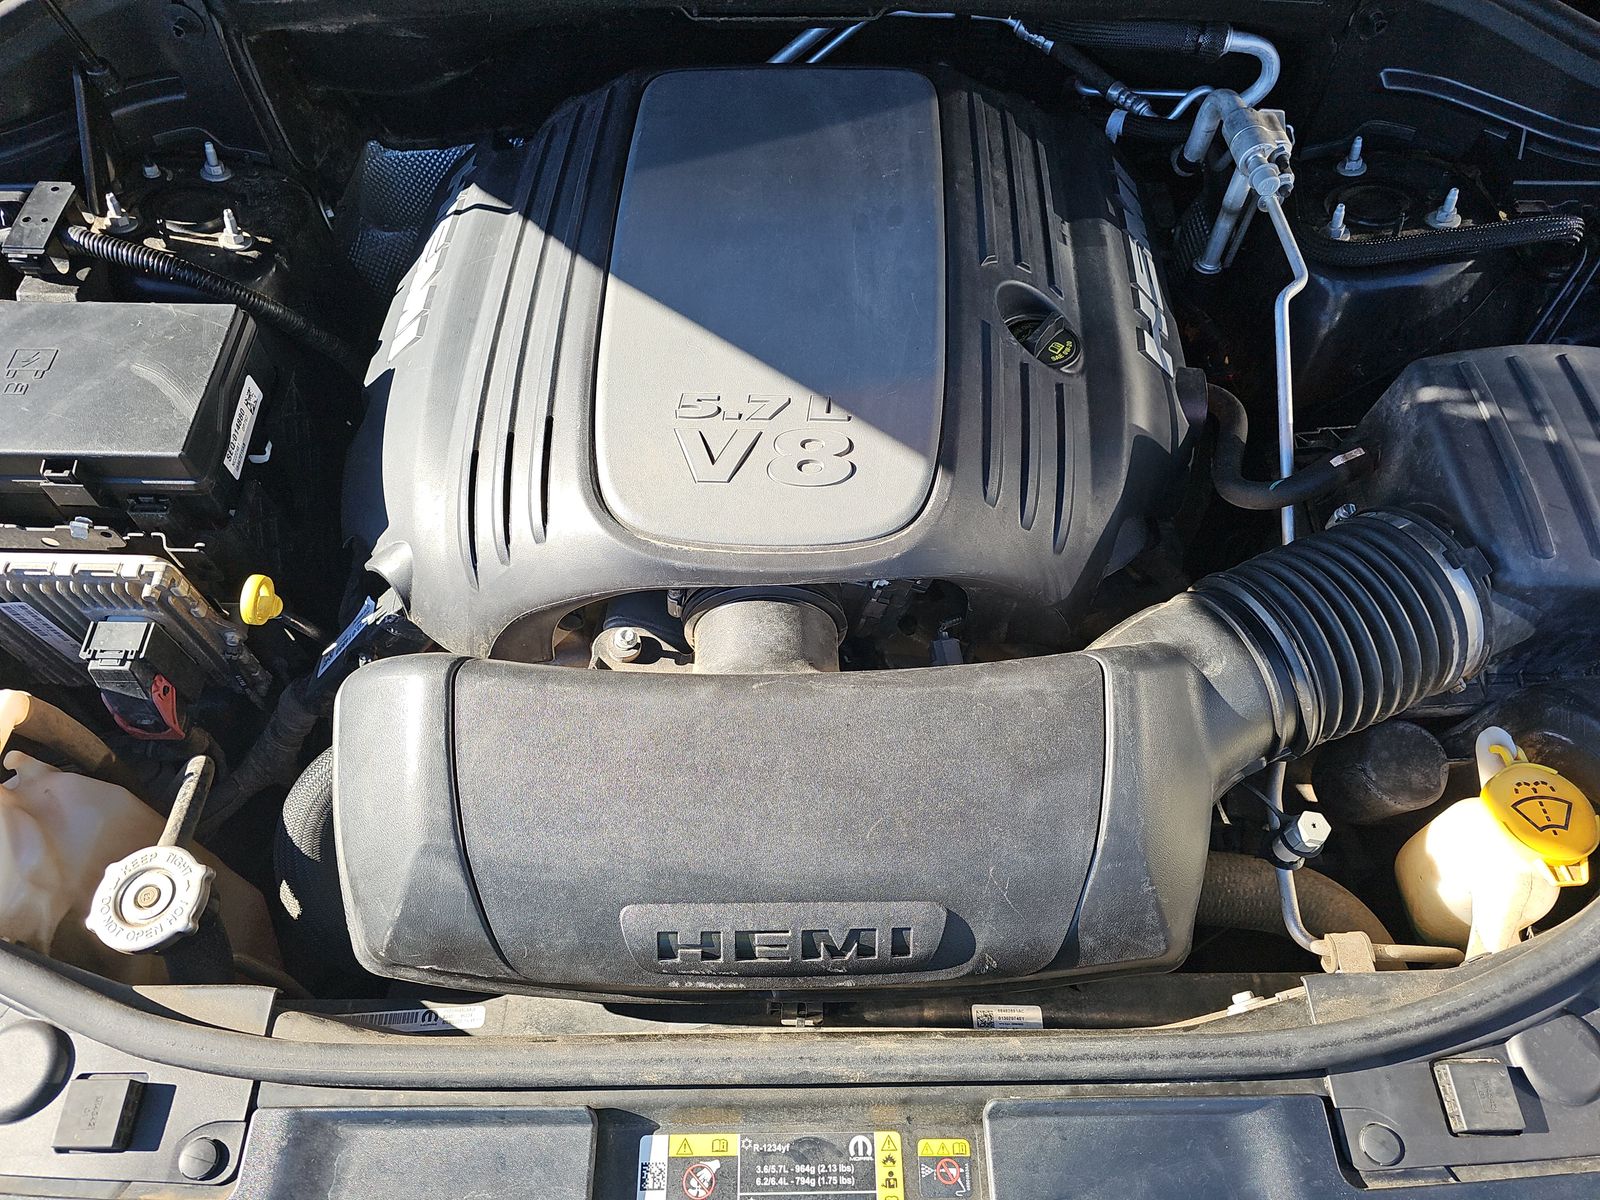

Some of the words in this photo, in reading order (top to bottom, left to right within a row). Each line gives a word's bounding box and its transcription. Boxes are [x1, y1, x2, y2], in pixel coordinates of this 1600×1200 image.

[674, 428, 857, 487] V8
[121, 852, 158, 875] KEEP
[166, 853, 193, 876] TIGHT
[101, 897, 112, 915] DO
[104, 916, 125, 937] NOT
[126, 923, 164, 942] OPEN
[657, 927, 912, 962] HEMI
[753, 1143, 790, 1153] R-1234yf
[756, 1165, 789, 1174] 3.6/5.7L
[795, 1165, 816, 1174] 964g
[817, 1164, 838, 1174] (2.13
[839, 1164, 855, 1174] lbs)
[756, 1177, 789, 1186] 6.2/6.4L
[795, 1177, 816, 1187] 794g
[817, 1176, 838, 1187] (1.75
[839, 1176, 856, 1187] lbs)
